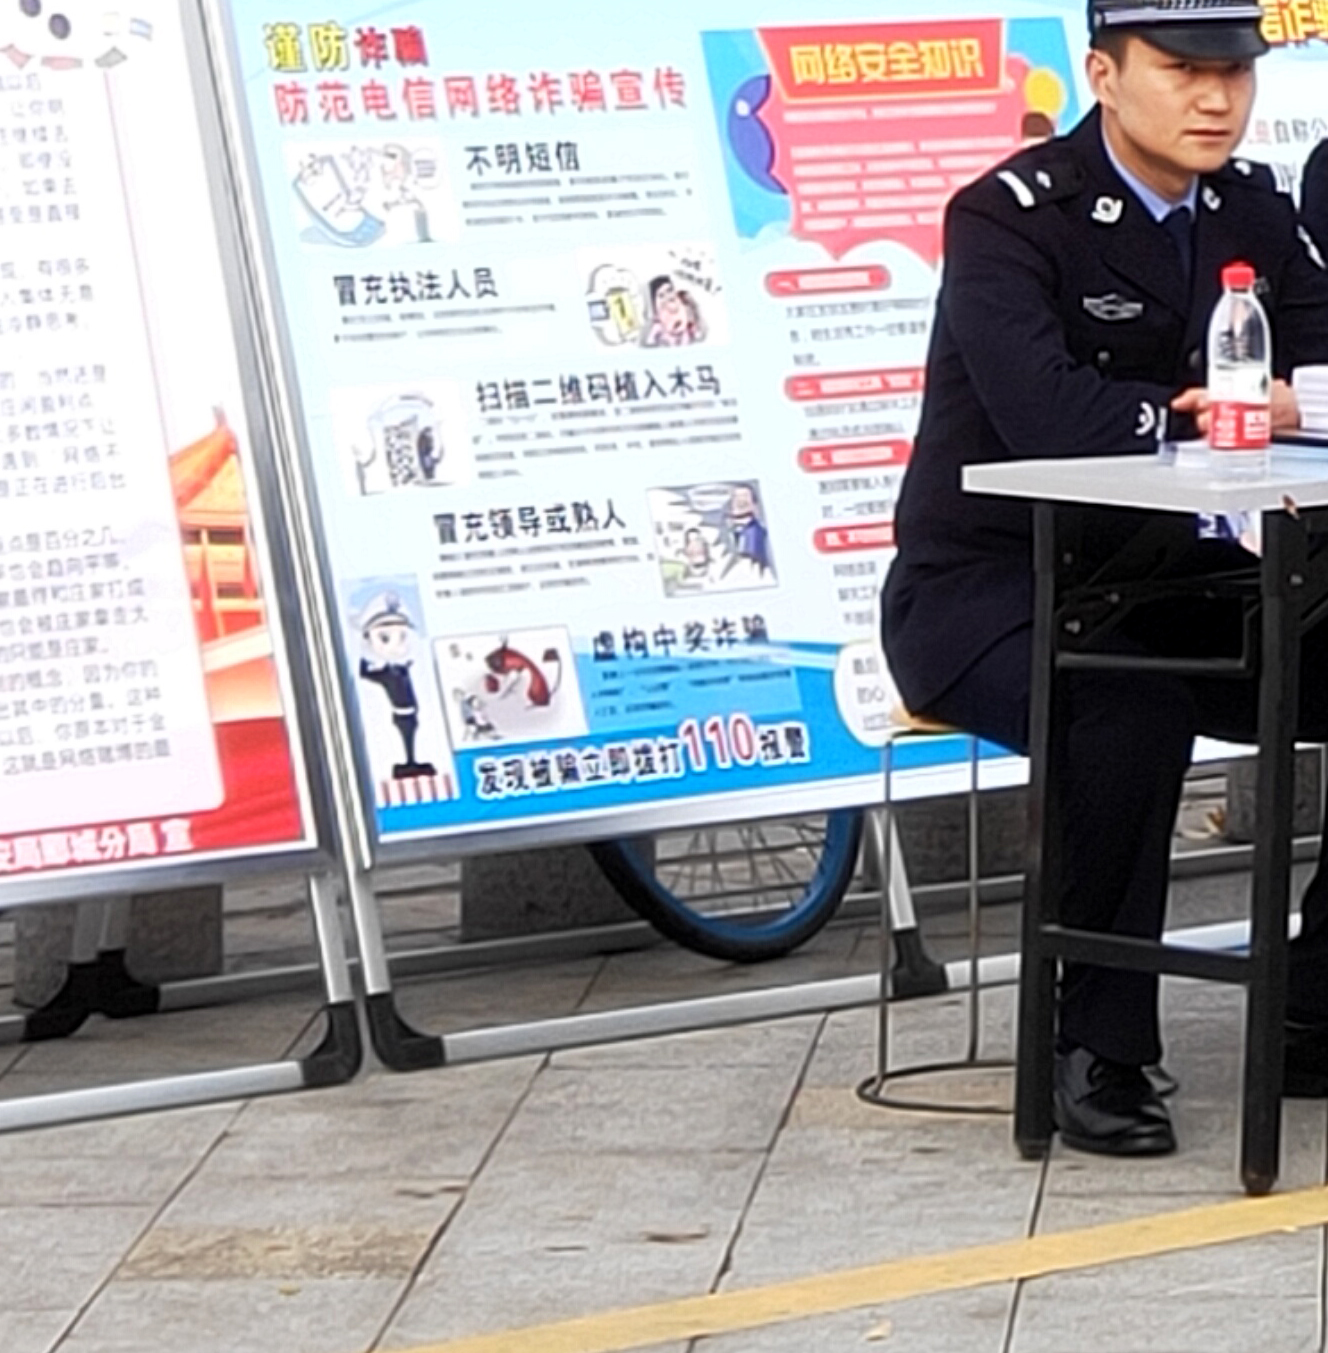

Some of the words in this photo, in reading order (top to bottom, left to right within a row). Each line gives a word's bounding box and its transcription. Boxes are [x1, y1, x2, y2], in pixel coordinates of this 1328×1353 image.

[789, 38, 984, 85] 网络安全知识
[274, 66, 688, 125] 防范电信网络诈骗宣传
[464, 142, 581, 176] 不明短信
[333, 267, 500, 306] 冒充执法人员
[475, 364, 722, 413] 扫描二维码植入木马
[432, 498, 627, 547] 冒充领导或熟人
[591, 614, 769, 663] 虚构中奖诈骗
[475, 712, 811, 800] 发现被骗立即拨打110报警
